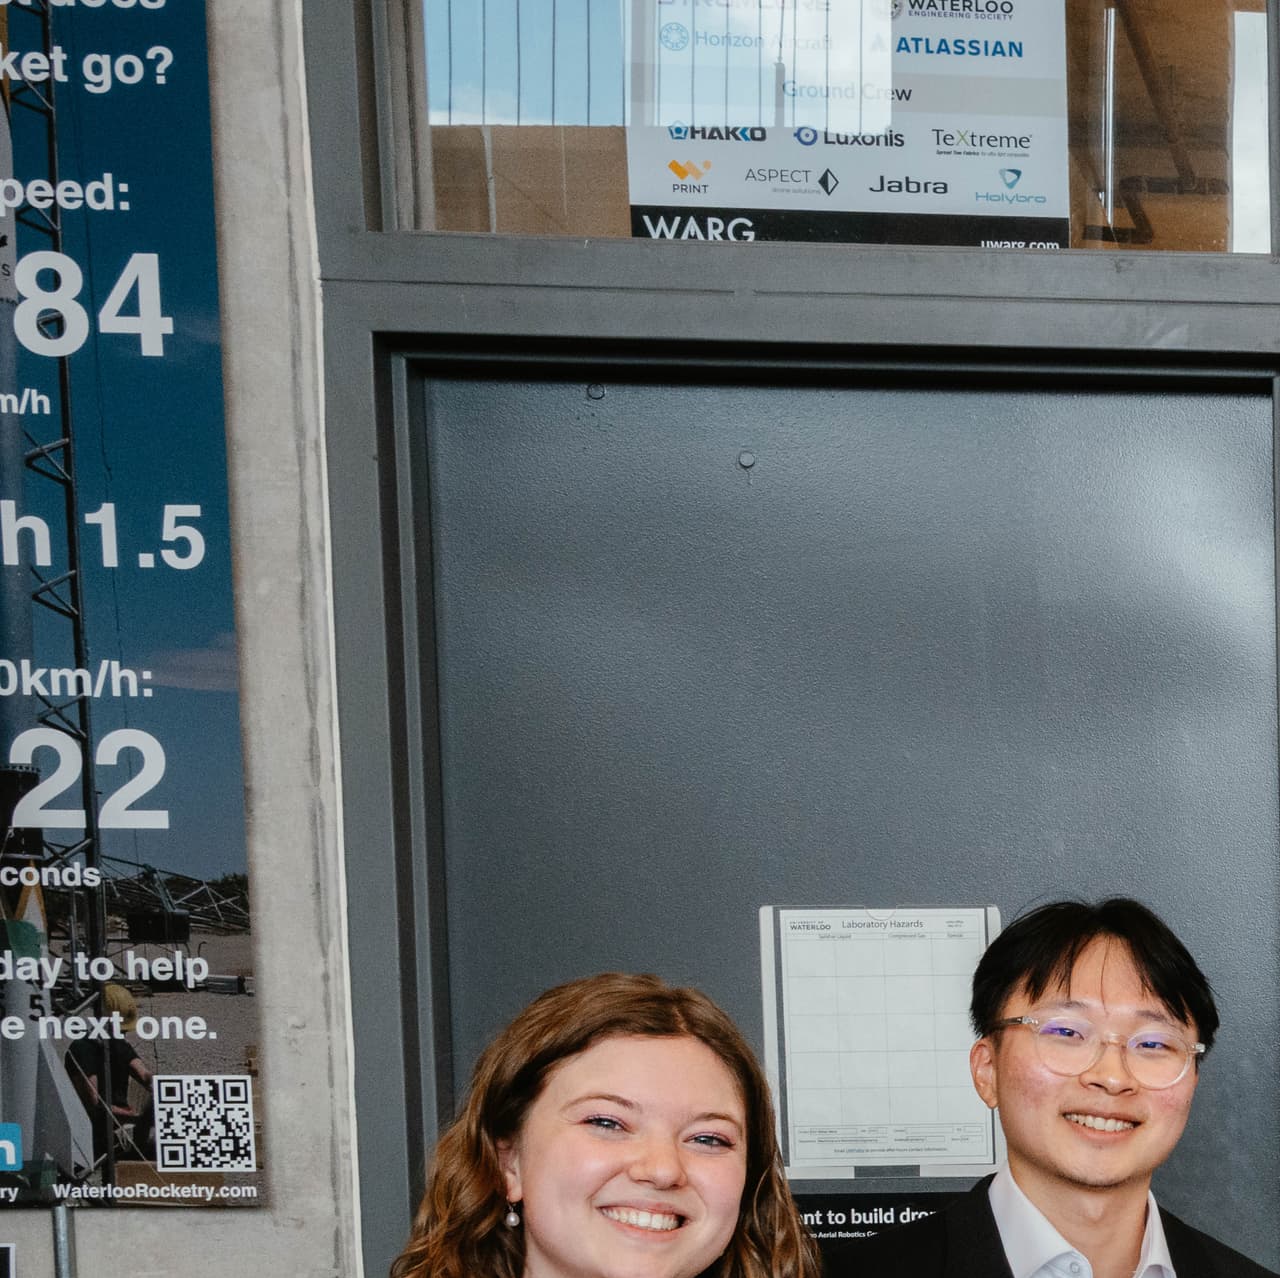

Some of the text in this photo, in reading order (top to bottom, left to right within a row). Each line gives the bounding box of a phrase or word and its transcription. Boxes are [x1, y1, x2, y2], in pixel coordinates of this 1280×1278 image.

[908, 0, 1014, 14] WATERLOO
[908, 9, 1014, 21] ENGINEERING SOCIETY
[694, 30, 764, 49] Horizon
[895, 36, 1024, 59] ATLASSIAN
[82, 45, 174, 94] go?
[782, 79, 856, 100] Ground
[823, 129, 905, 148] Luxonis
[931, 128, 1032, 150] TeXtreme
[744, 167, 812, 184] ASPECT
[868, 175, 949, 195] Jabra
[672, 183, 710, 195] PRINT
[974, 191, 1048, 205] Holybro
[642, 214, 756, 243] WARG
[14, 250, 174, 357] 84
[85, 503, 206, 571] 1.5
[9, 727, 170, 830] 22
[789, 923, 832, 931] WATERLOO
[841, 919, 925, 931] Laboratory Hazards
[75, 951, 115, 981] to
[127, 950, 209, 989] help
[39, 1011, 125, 1040] next
[136, 1014, 218, 1040] one.
[52, 1183, 258, 1202] WaterlooRocketry.com
[826, 1210, 847, 1225] to
[850, 1207, 895, 1225] build
[818, 1231, 838, 1239] Aerial
[838, 1230, 866, 1239] Robotics
